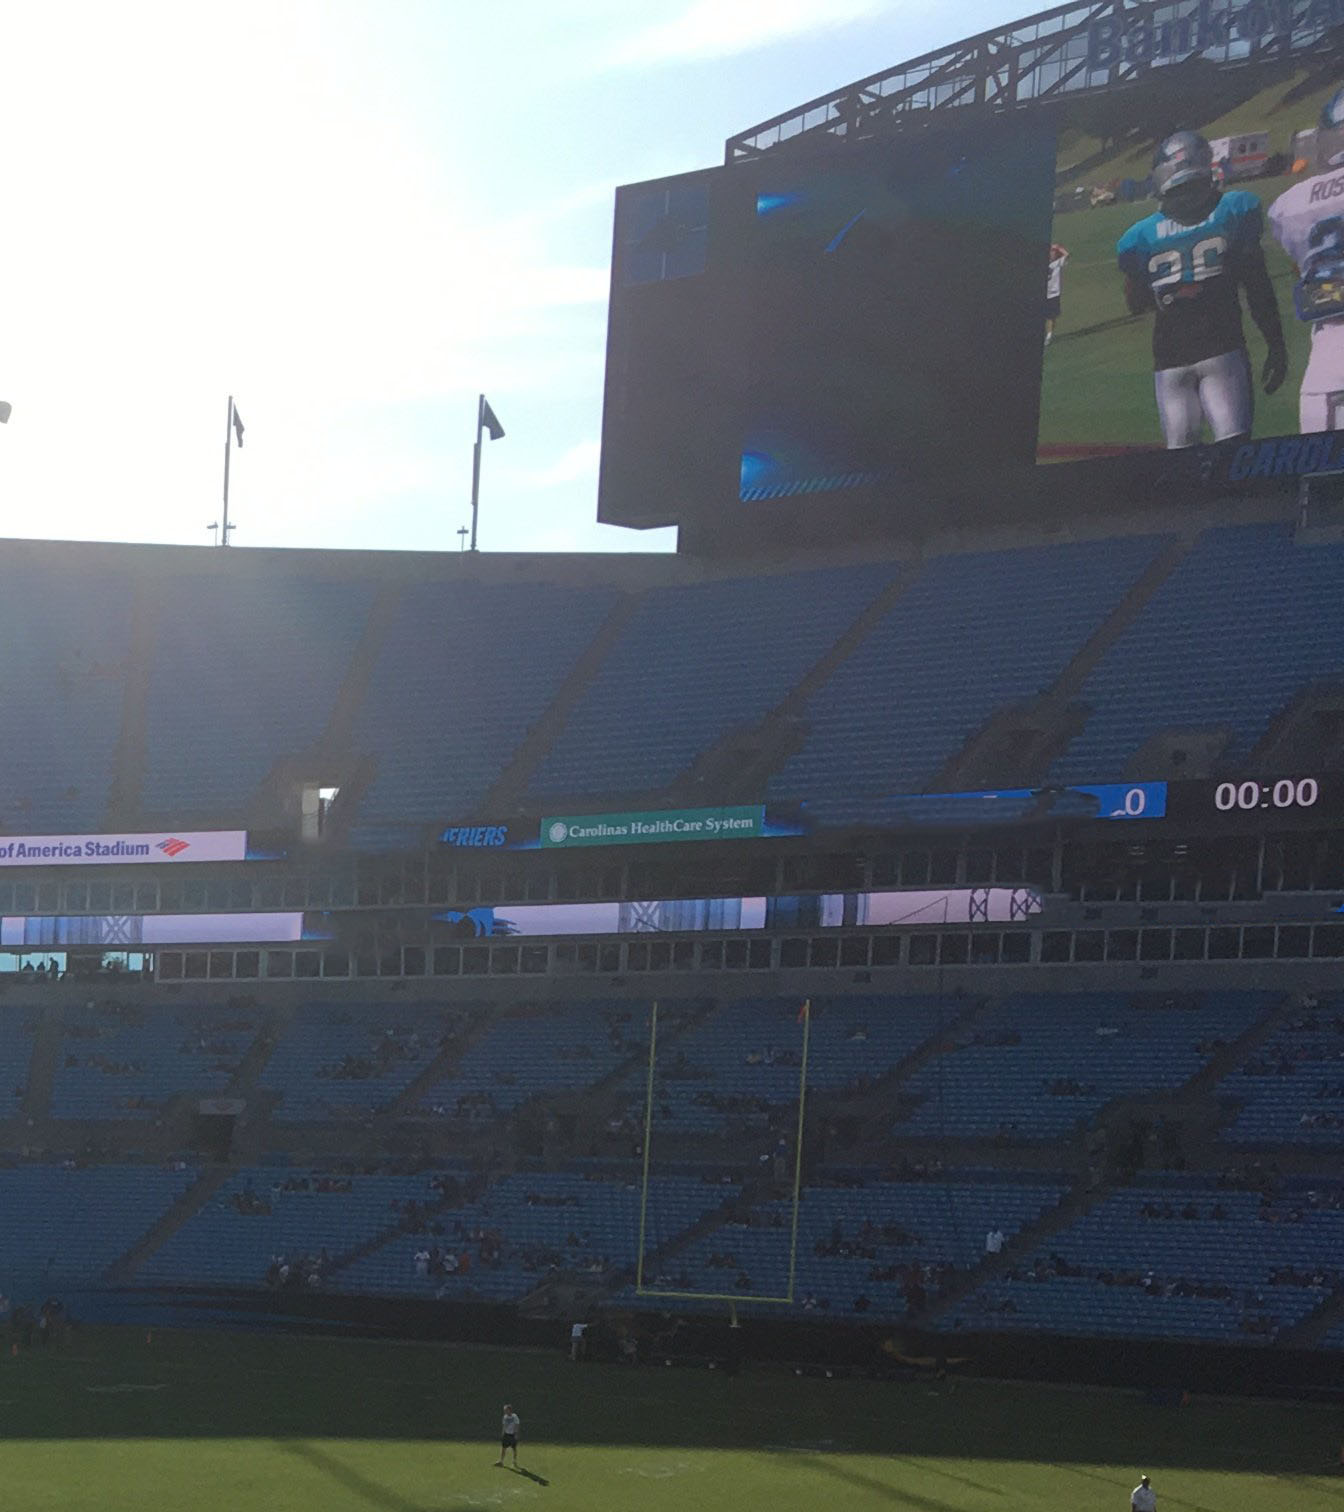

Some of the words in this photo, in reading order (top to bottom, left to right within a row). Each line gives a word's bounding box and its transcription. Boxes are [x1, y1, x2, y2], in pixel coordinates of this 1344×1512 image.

[1214, 778, 1319, 811] 00:00
[569, 823, 628, 839] Carolinas
[630, 819, 704, 835] HealthCare
[705, 817, 754, 833] System
[16, 842, 83, 858] America
[84, 841, 150, 857] Stadium
